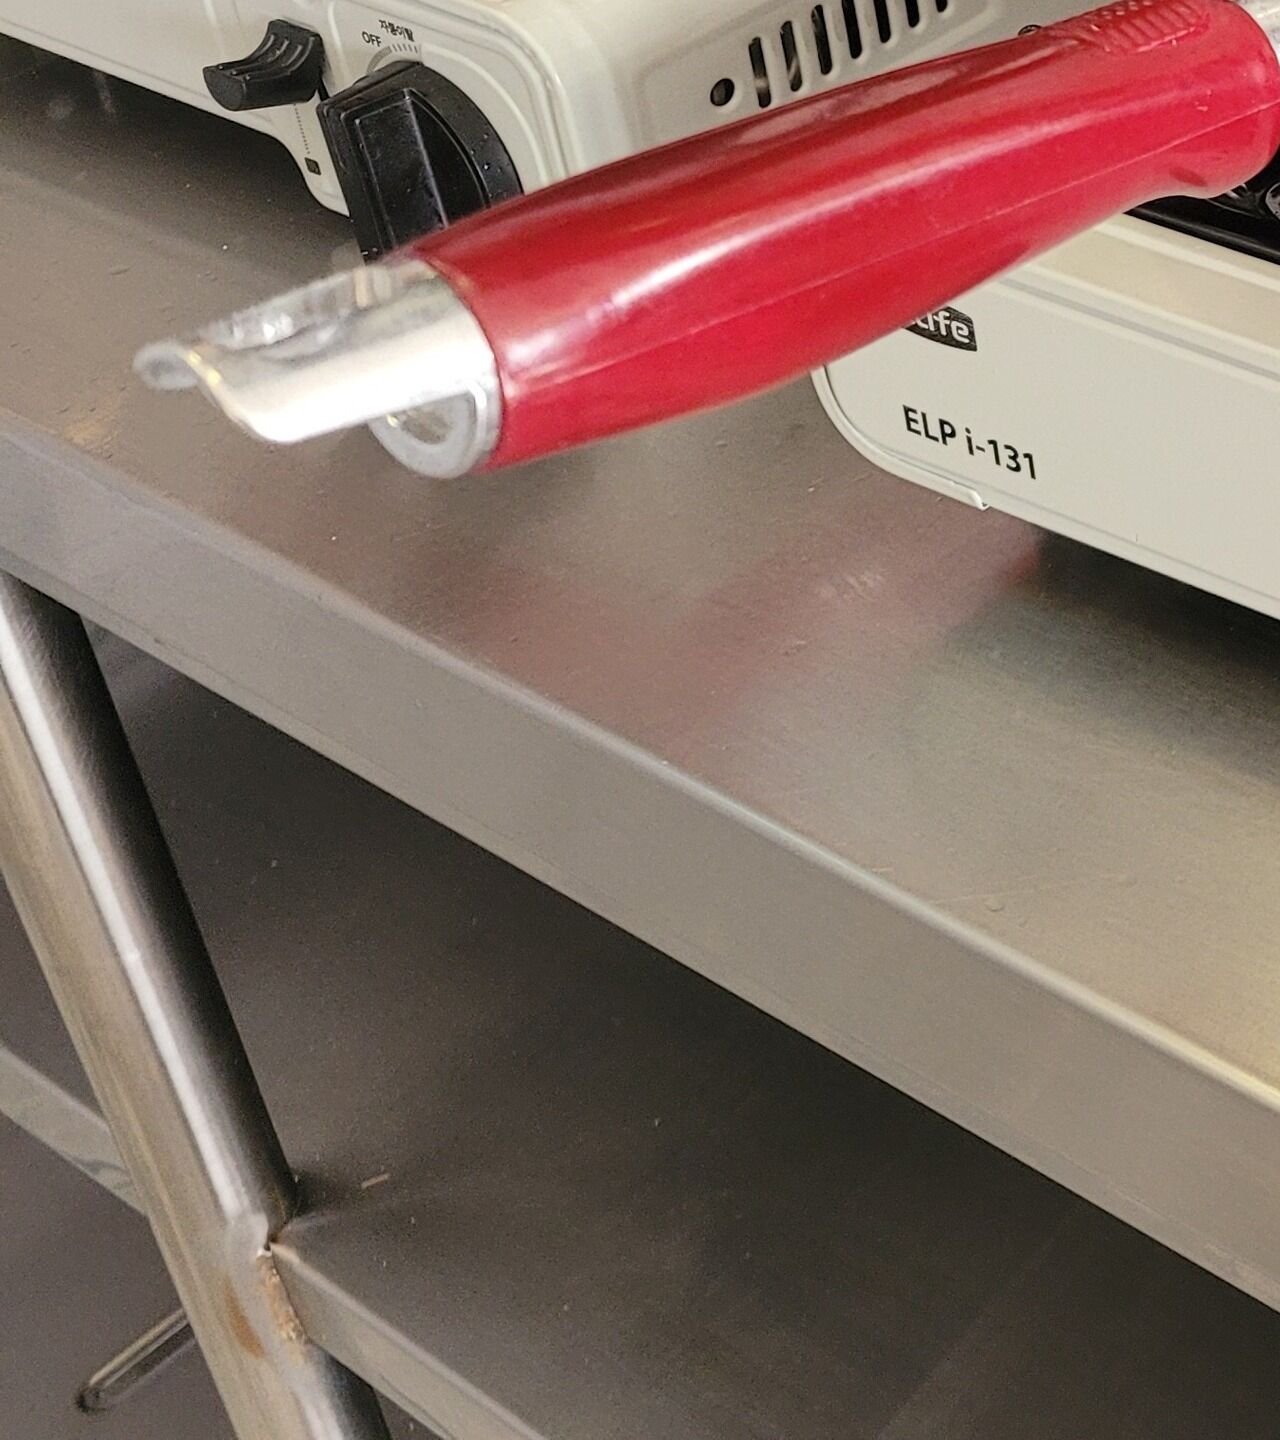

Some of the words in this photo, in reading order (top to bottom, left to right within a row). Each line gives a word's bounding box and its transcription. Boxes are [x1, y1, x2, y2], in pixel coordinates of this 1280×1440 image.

[362, 31, 381, 47] OFF
[902, 404, 957, 446] ELP
[965, 427, 1037, 481] i-131
